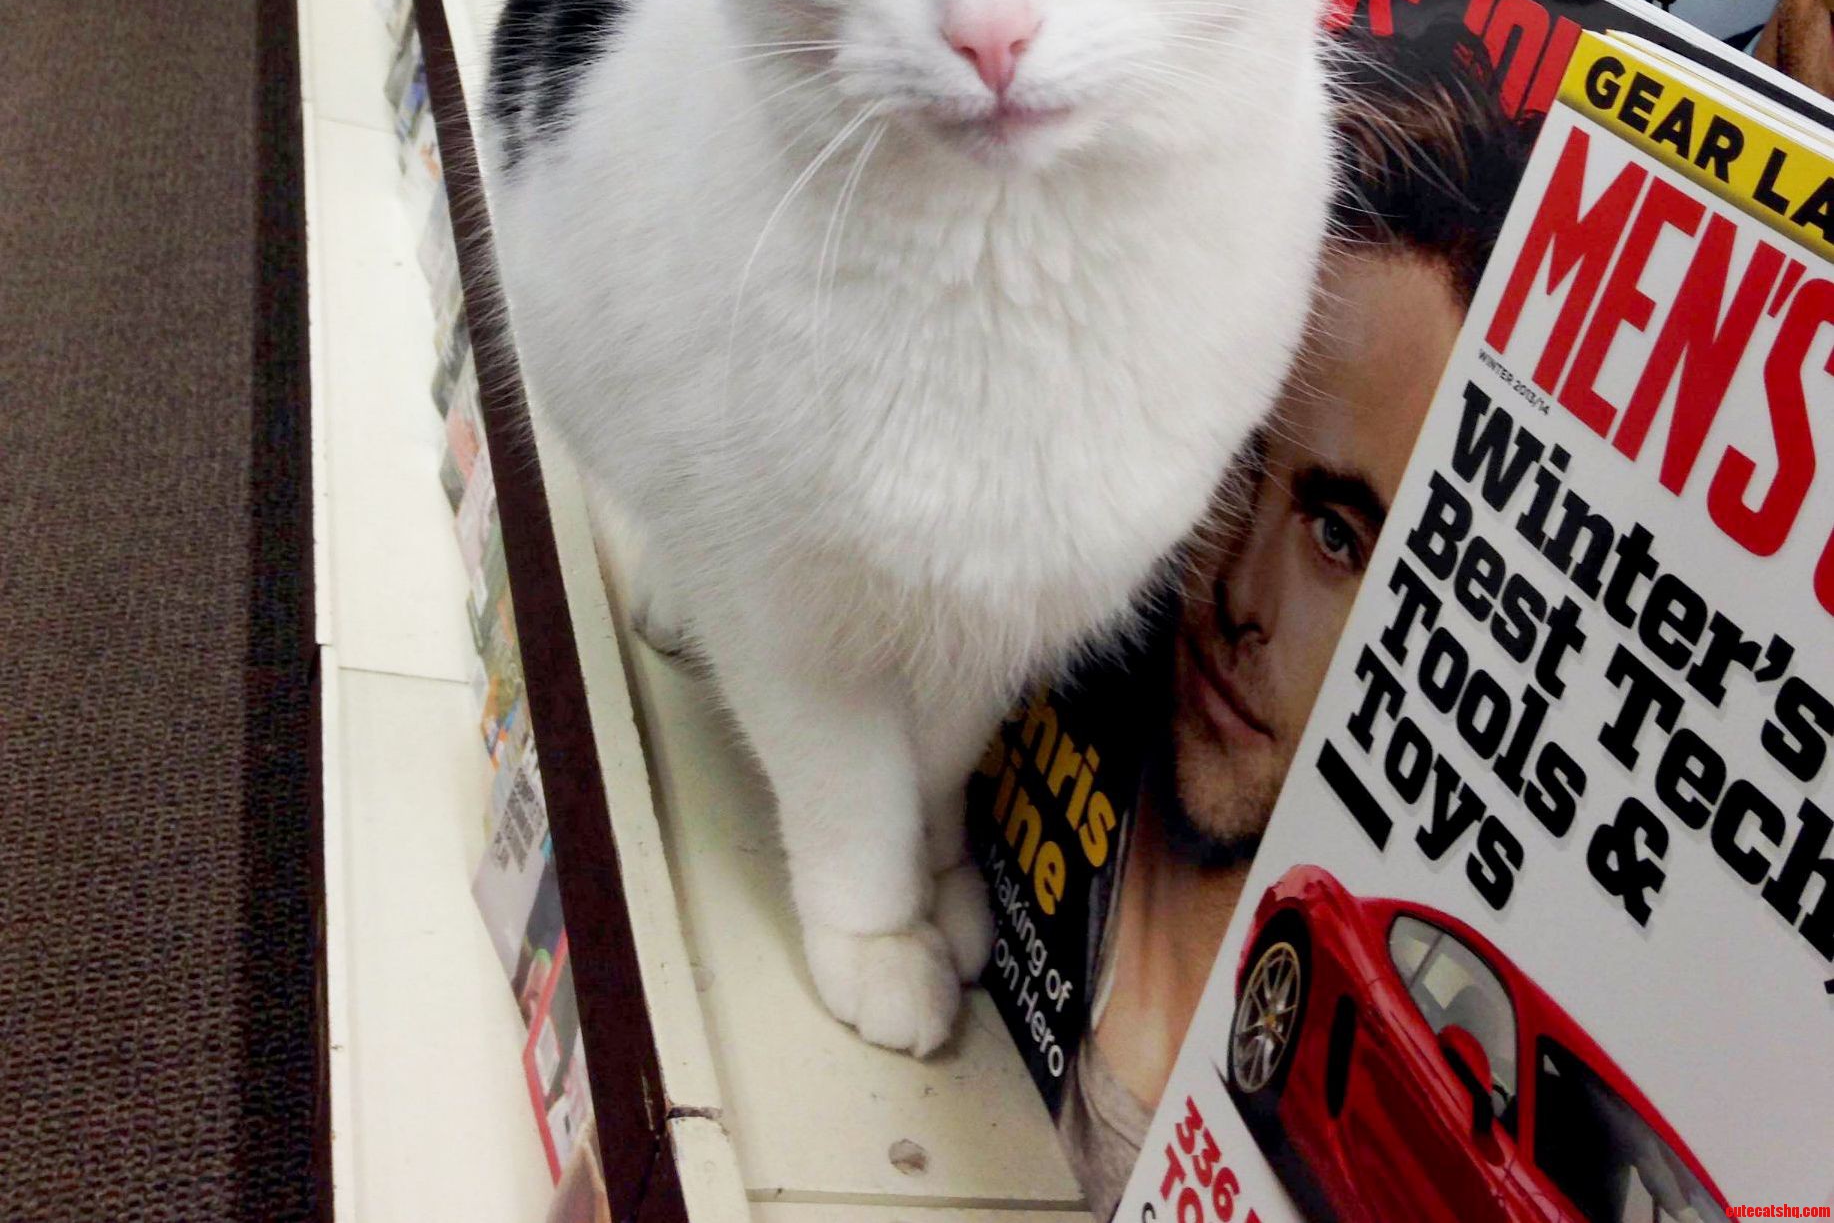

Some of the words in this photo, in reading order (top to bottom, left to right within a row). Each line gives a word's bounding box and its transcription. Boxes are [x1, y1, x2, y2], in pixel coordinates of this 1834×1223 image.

[1584, 55, 1745, 183] GEAR
[1479, 349, 1514, 386] WINTER
[1513, 379, 1550, 416] 2013/14
[1484, 125, 1834, 557] MEN'S
[1453, 380, 1834, 783] Winter's
[1346, 644, 1525, 912] Toys
[1379, 558, 1588, 839] Tools
[1586, 796, 1670, 928] &
[1406, 469, 1588, 700] Best
[1598, 645, 1834, 963] Tech
[1016, 975, 1065, 1078] Hero
[1045, 968, 1074, 1013] of
